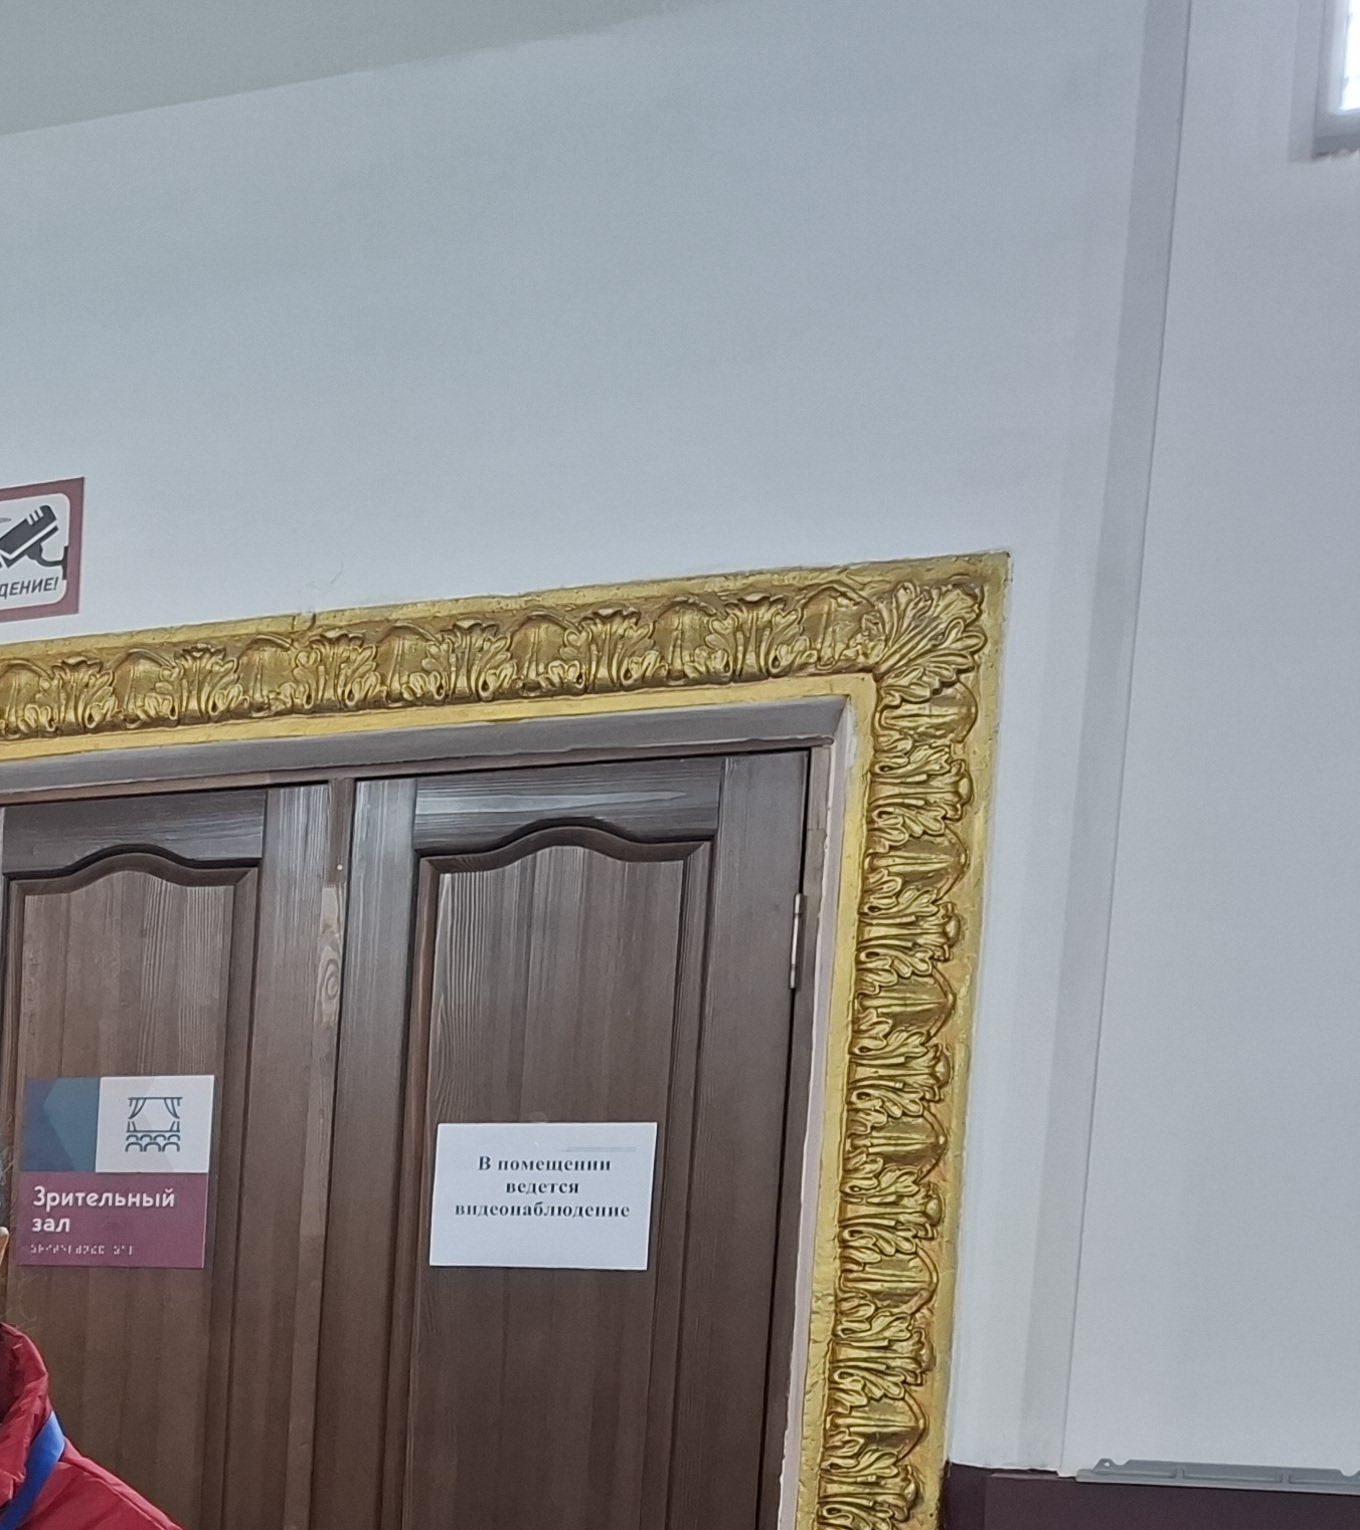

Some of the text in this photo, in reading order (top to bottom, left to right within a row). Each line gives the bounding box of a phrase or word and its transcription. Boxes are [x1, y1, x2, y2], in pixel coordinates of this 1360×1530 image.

[478, 1156, 611, 1173] В помещении
[505, 1181, 579, 1195] ведется
[32, 1185, 175, 1212] Зрительный
[454, 1201, 631, 1219] видеонаблюдение
[31, 1217, 71, 1233] зал
